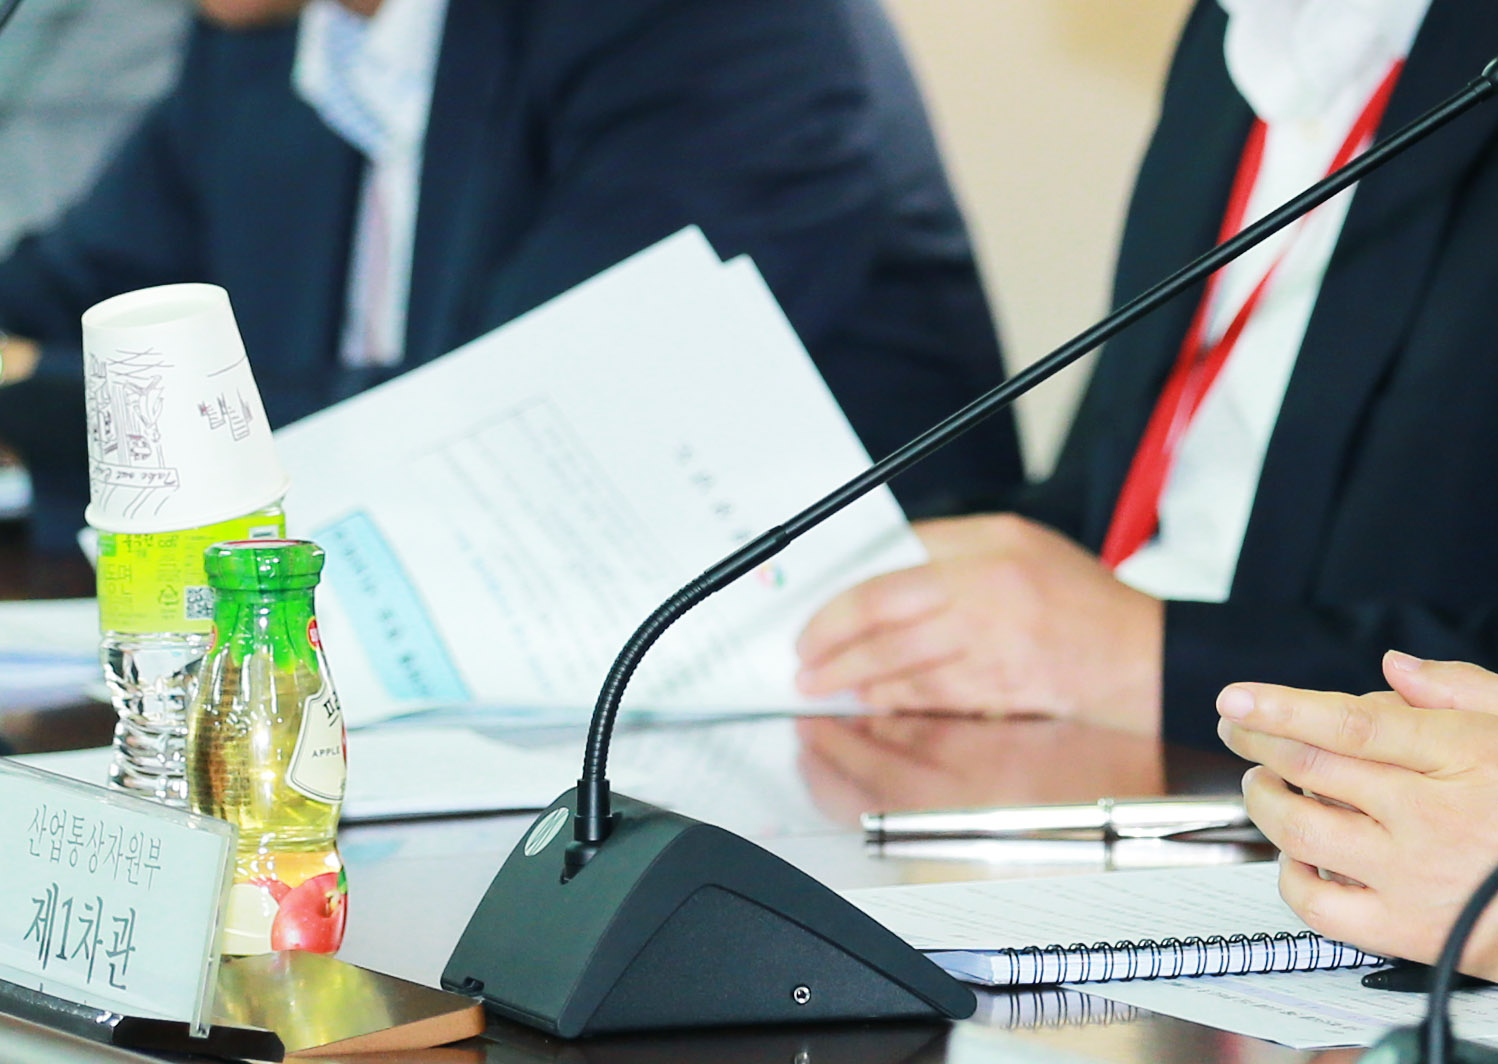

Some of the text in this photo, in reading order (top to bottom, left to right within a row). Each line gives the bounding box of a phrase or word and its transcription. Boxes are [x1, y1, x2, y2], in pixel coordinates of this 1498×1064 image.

[141, 470, 177, 487] Take
[311, 747, 341, 758] APPLE
[27, 803, 162, 891] 산업통상자원부
[23, 882, 137, 991] 제1차관
